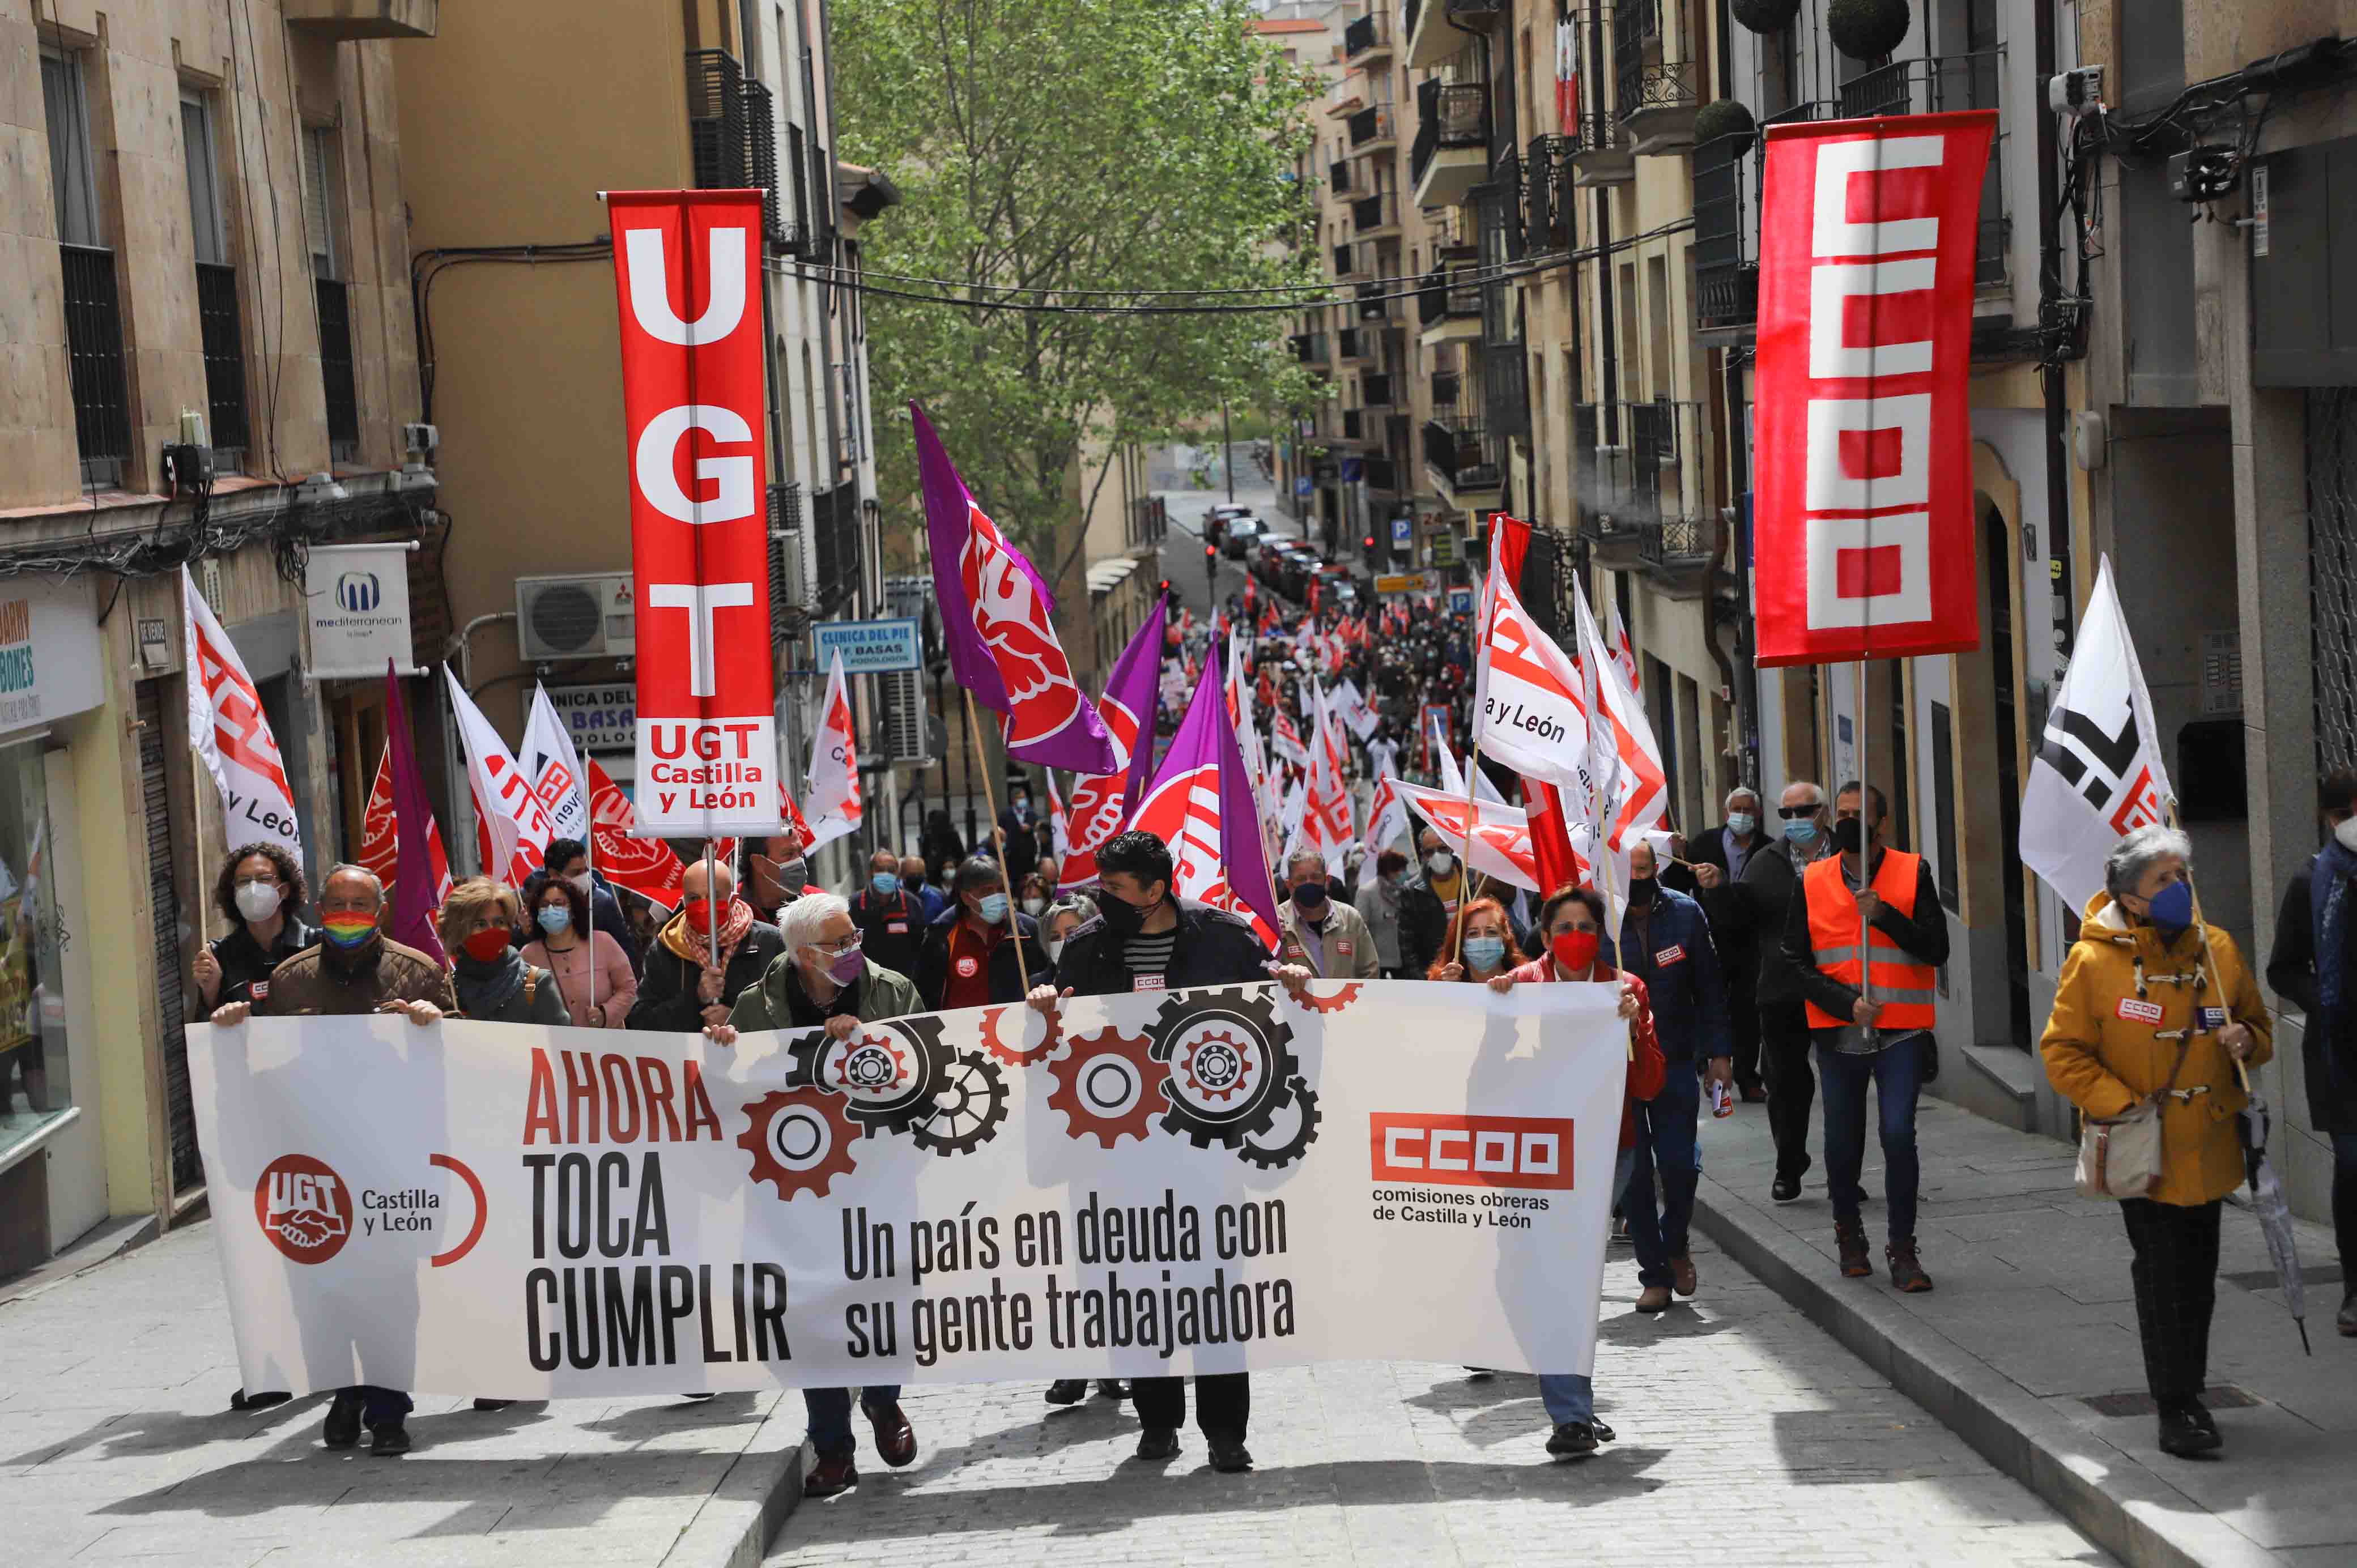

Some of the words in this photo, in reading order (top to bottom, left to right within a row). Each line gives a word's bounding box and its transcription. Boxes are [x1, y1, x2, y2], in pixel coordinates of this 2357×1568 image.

[1806, 135, 1944, 630] CCOO
[625, 227, 755, 697] UGT
[1396, 521, 1407, 538] P
[1456, 595, 1466, 610] P
[317, 616, 402, 628] mediterranean
[603, 691, 635, 705] DEL
[572, 708, 634, 730] BASA
[1496, 704, 1512, 725] y
[1513, 704, 1565, 743] León
[651, 723, 759, 761] UGT
[651, 762, 761, 784] Castilla
[659, 792, 677, 813] y
[690, 785, 755, 809] León
[1658, 948, 1678, 960] CCOO
[255, 983, 268, 991] CC
[522, 1047, 723, 1145] AHORA
[1384, 1126, 1559, 1174] CCOO
[267, 1171, 342, 1216] UGT
[361, 1189, 440, 1209] Castilla
[522, 1151, 670, 1259] TOCA
[1372, 1187, 1475, 1206] comisiones
[1480, 1192, 1550, 1211] obreras
[363, 1217, 376, 1236] y
[382, 1211, 432, 1232] León
[1372, 1205, 1396, 1220] de
[1401, 1205, 1467, 1225] Castilla
[1473, 1213, 1483, 1228] y
[1488, 1210, 1531, 1229] León
[843, 1207, 895, 1281] Un
[910, 1200, 1000, 1286] país
[1014, 1209, 1063, 1267] en
[1077, 1188, 1201, 1265] deuda
[1215, 1198, 1287, 1260] con
[526, 1262, 792, 1371] CUMPLIR
[845, 1301, 897, 1358] su
[911, 1276, 1033, 1367] gente
[1045, 1267, 1295, 1360] trabajadora
